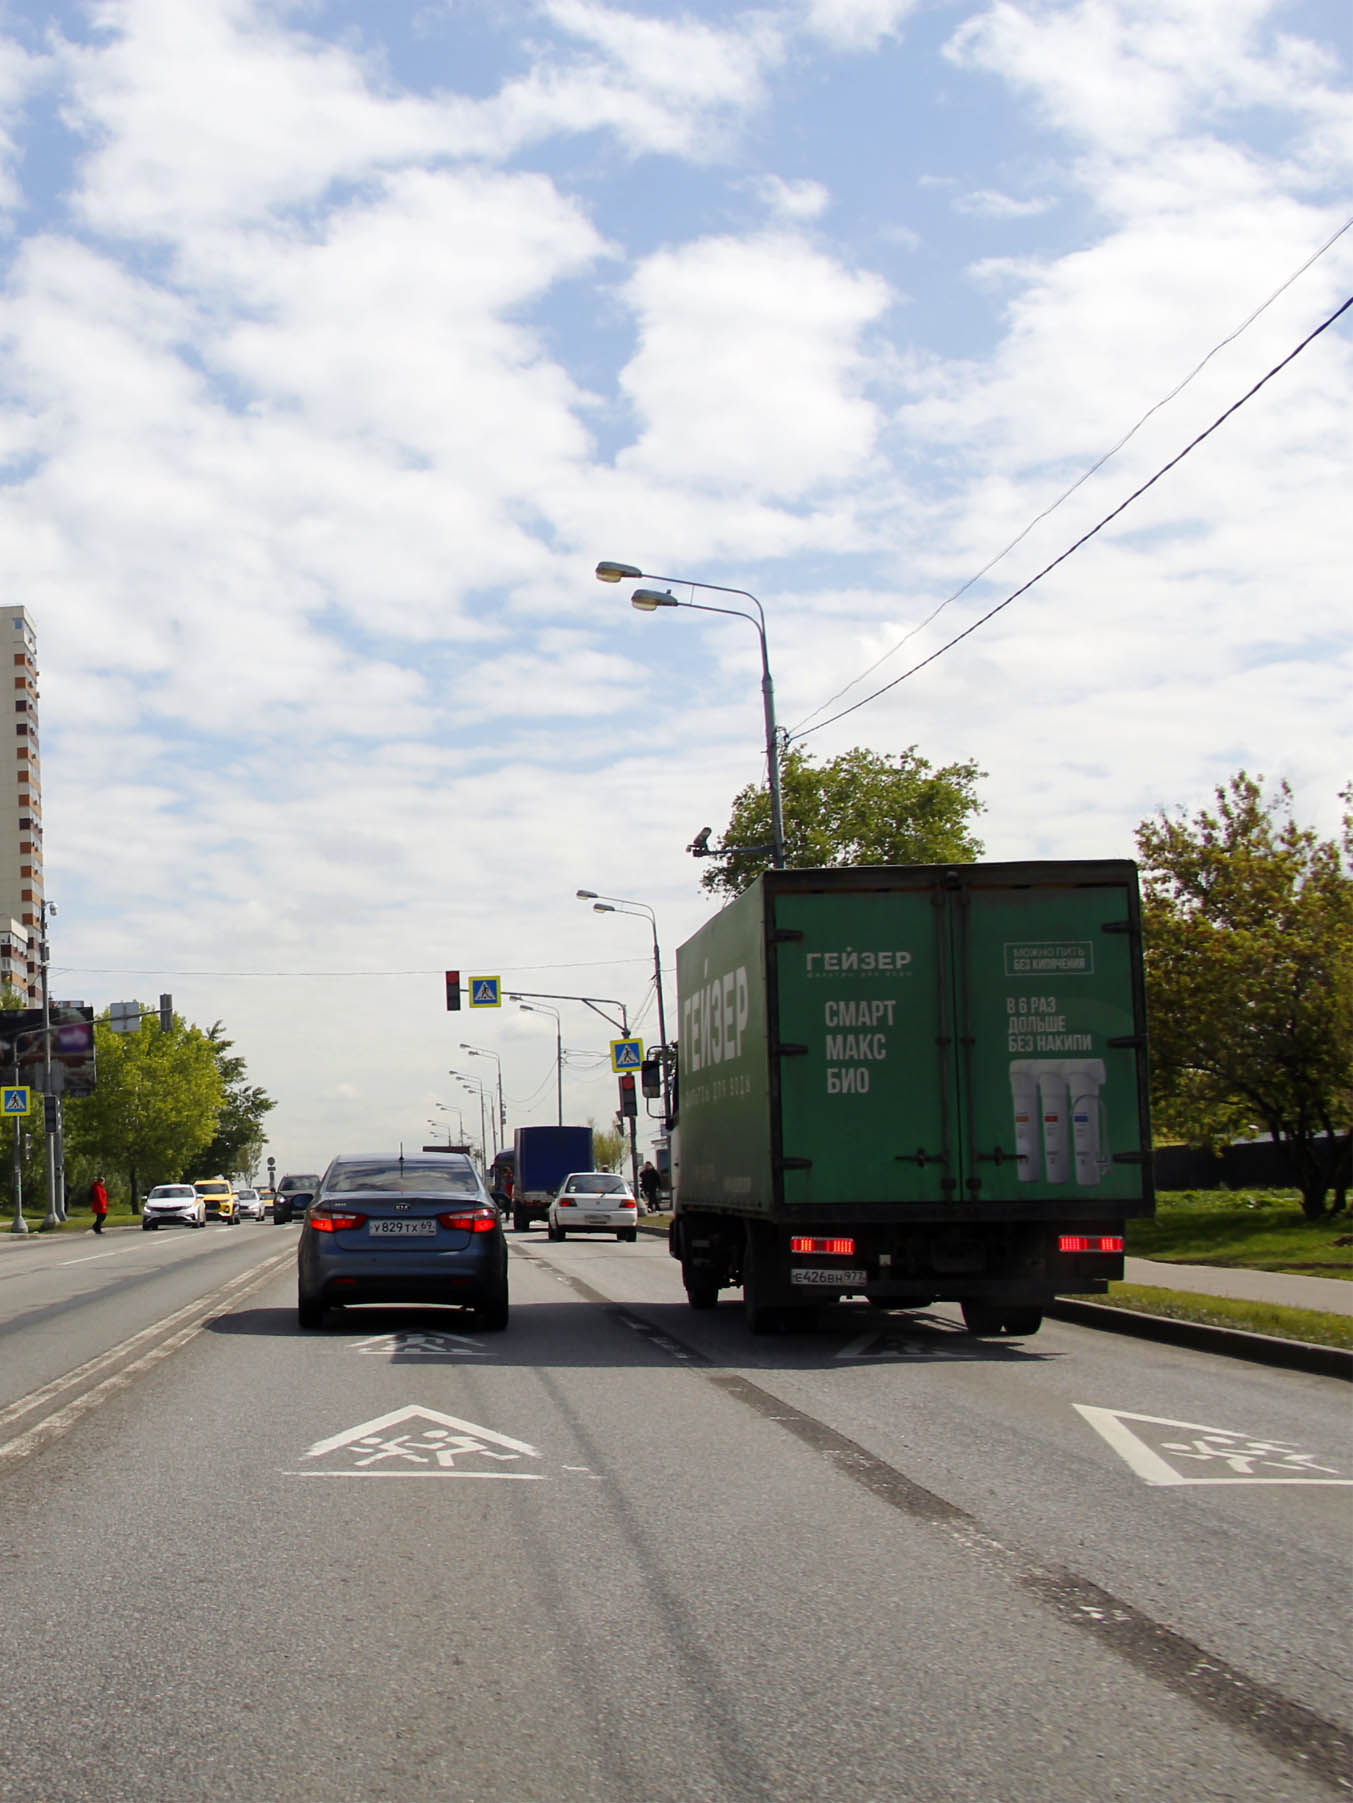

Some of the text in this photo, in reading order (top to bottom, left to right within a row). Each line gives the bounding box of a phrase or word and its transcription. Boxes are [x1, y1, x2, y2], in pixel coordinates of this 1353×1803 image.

[806, 946, 913, 971] ГЕЙЗЕР
[684, 957, 749, 1075] ГЕЙЗЕР
[824, 1000, 897, 1027] СМАРТ
[1007, 996, 1056, 1013] В 6 РАЗ
[1008, 1015, 1067, 1034] ДОЛЬШЕ
[826, 1034, 887, 1060] МАКС
[1008, 1033, 1093, 1052] БЕЗ НАКИПИ
[826, 1067, 870, 1094] БИО
